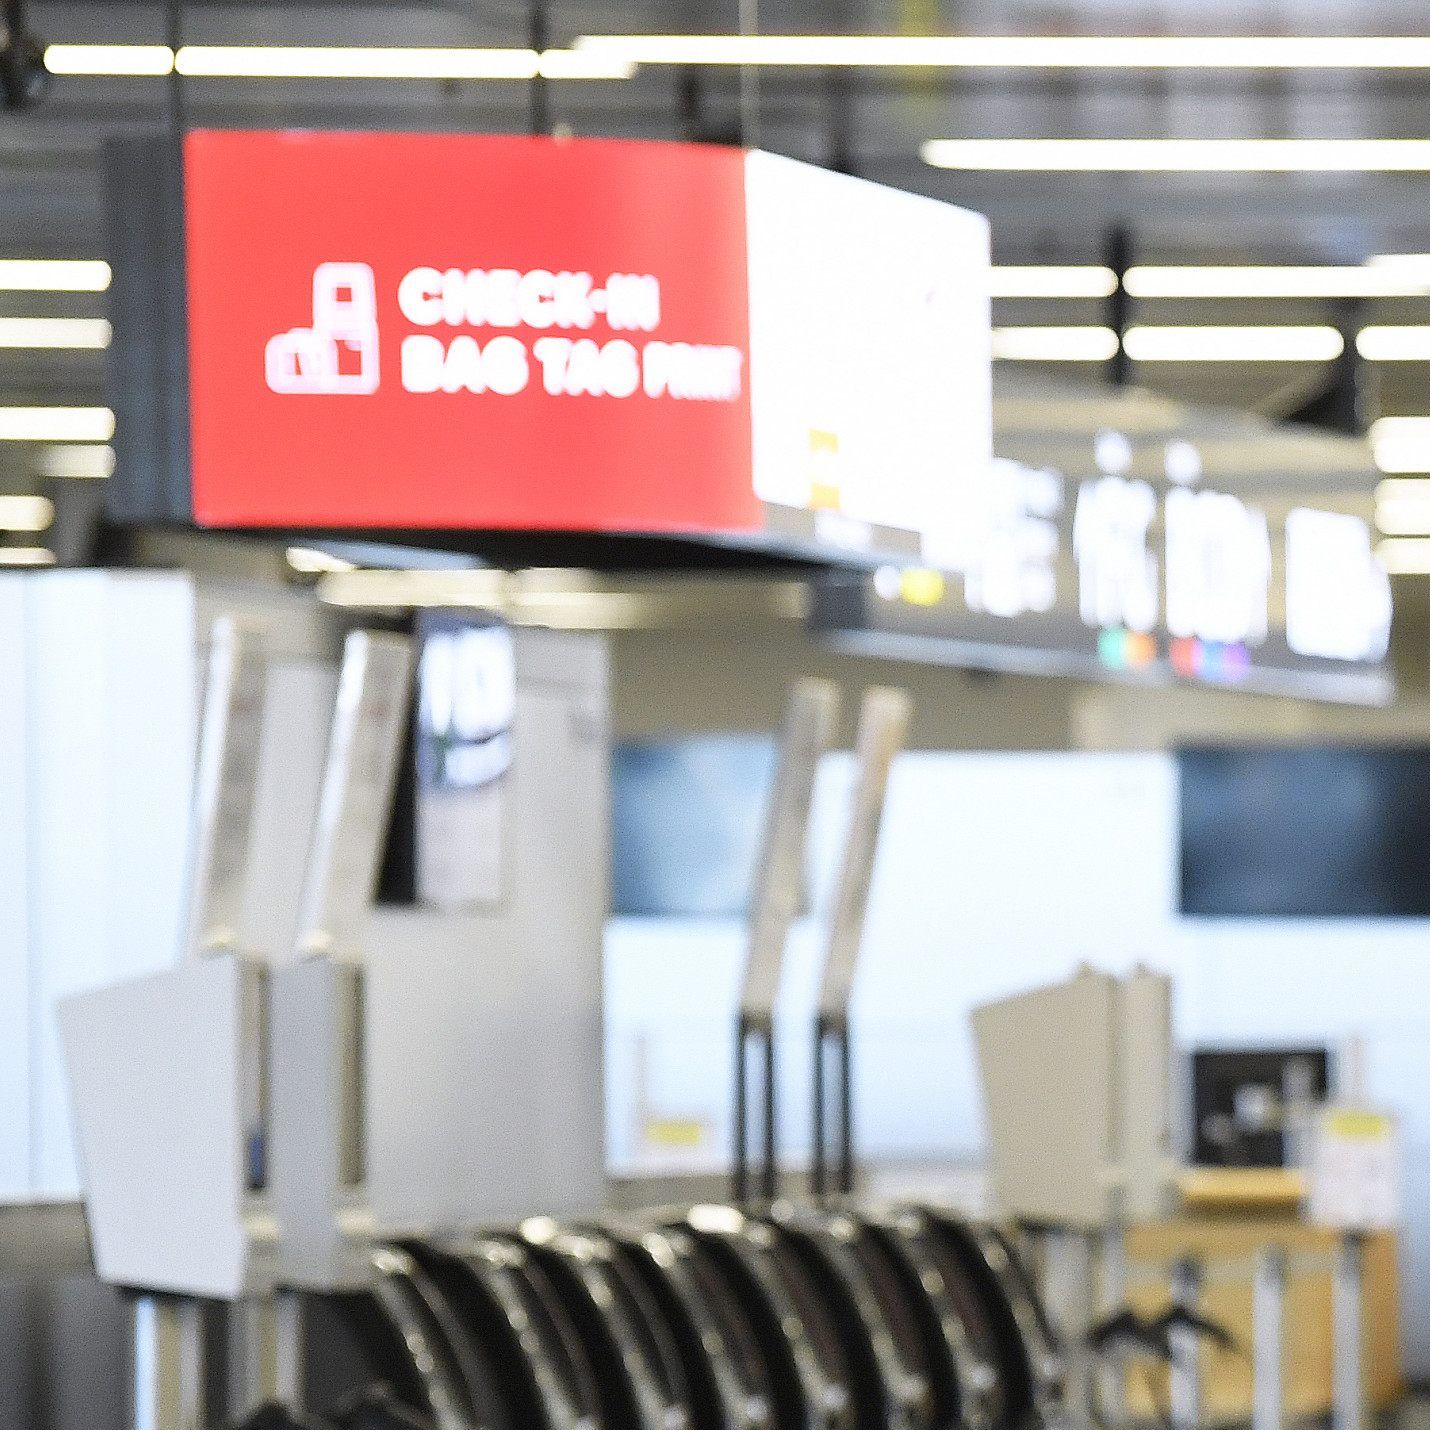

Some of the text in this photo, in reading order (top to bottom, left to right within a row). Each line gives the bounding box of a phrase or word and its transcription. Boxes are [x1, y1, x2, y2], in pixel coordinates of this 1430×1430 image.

[398, 266, 660, 331] CHECK-IN
[401, 334, 529, 395] BAG
[533, 336, 639, 398] TAG
